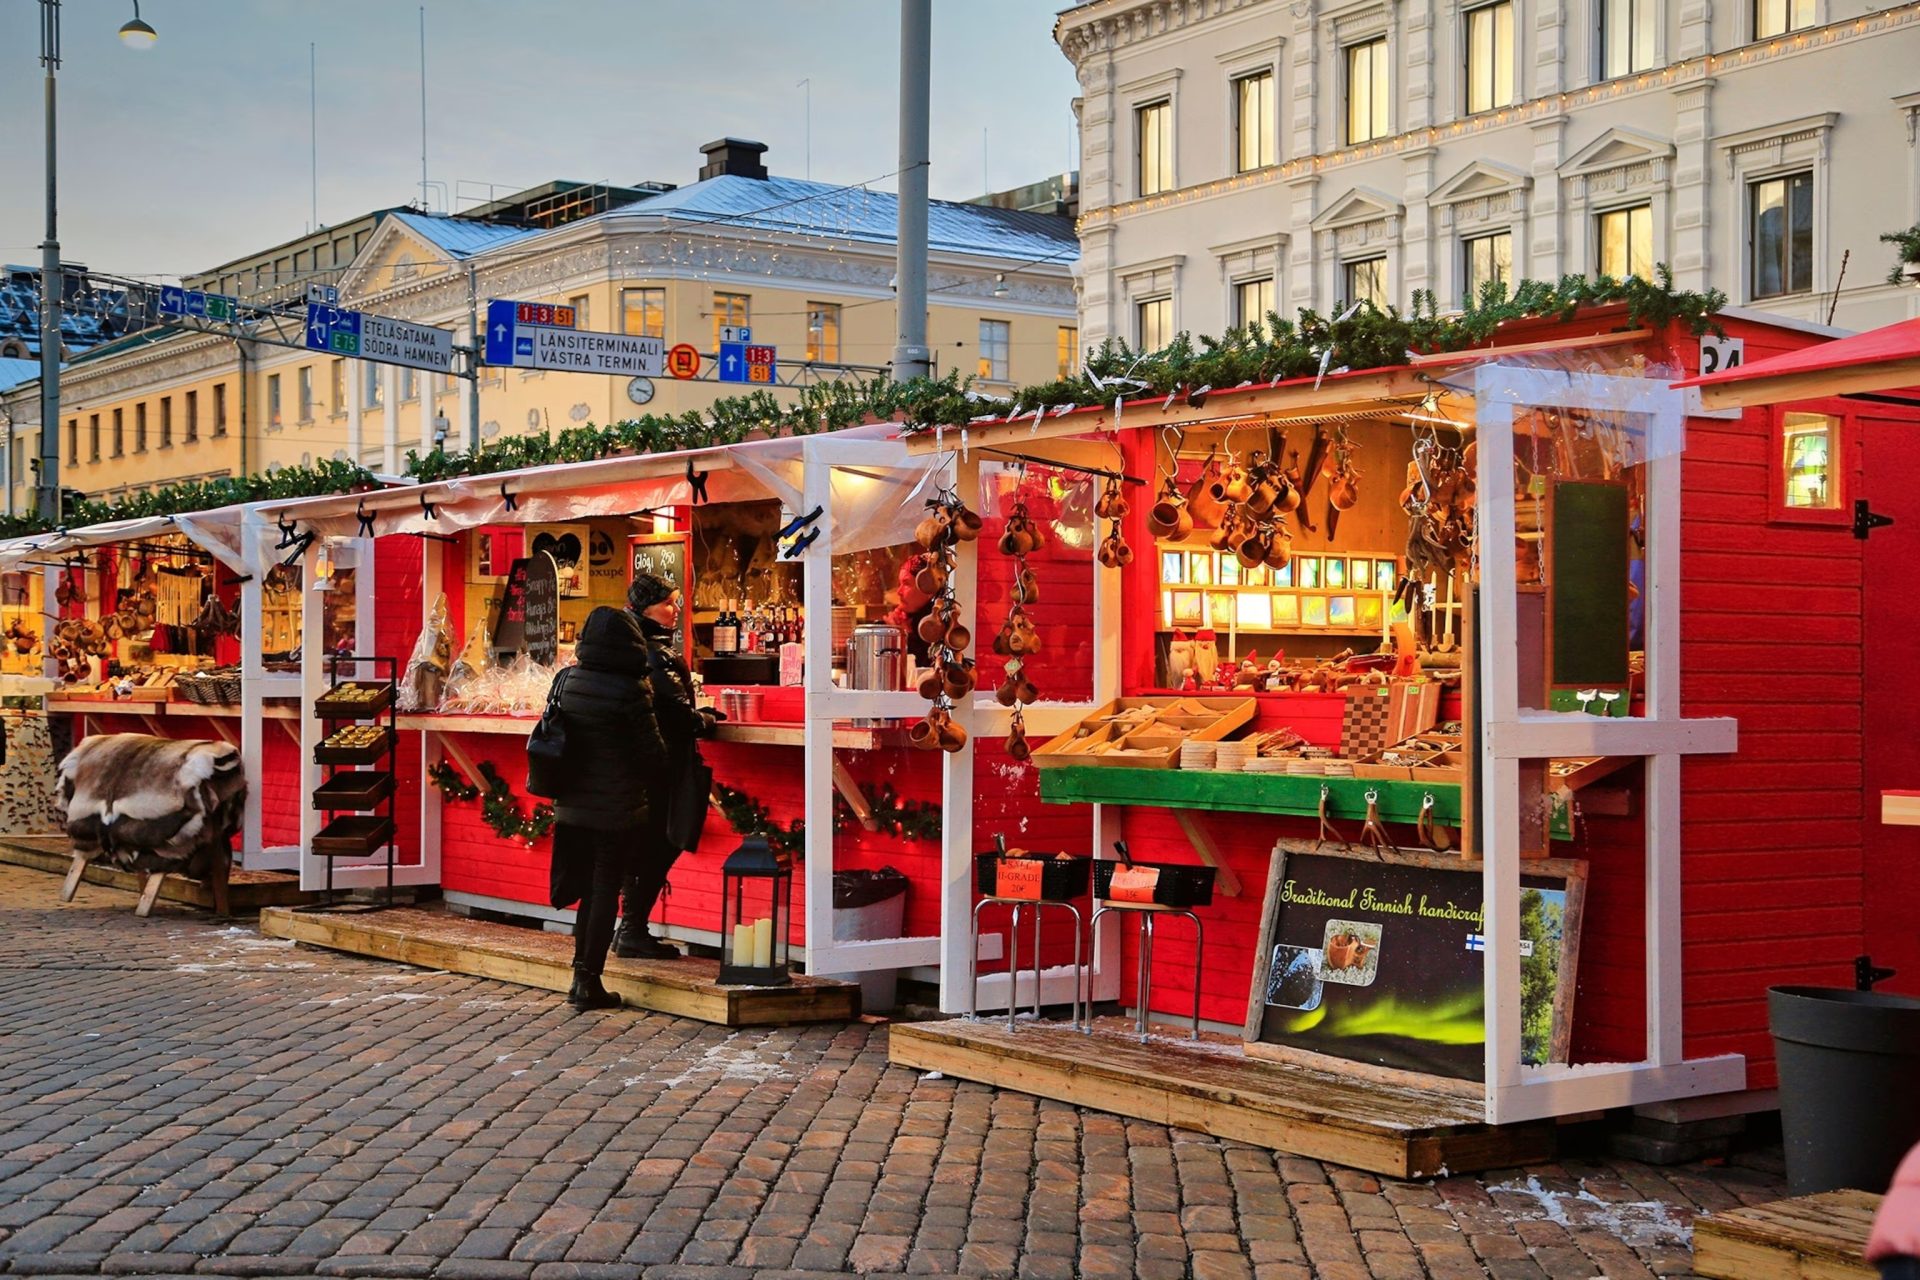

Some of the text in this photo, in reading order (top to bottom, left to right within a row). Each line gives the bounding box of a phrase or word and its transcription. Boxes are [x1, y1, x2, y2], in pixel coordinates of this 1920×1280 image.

[540, 308, 548, 322] 3
[558, 310, 570, 324] 51
[364, 320, 436, 347] ETELÄSATAMA
[740, 329, 749, 341] P
[540, 332, 658, 356] LÄNSITERMINAALI
[364, 337, 448, 367] SÖDRA HAMNEN
[763, 350, 771, 362] 3
[540, 348, 650, 372] VÄSTRA TERMIN.
[754, 367, 766, 380] 51
[589, 566, 625, 578] oxupé
[1281, 880, 1485, 932] Traditional Finnish handicraf
